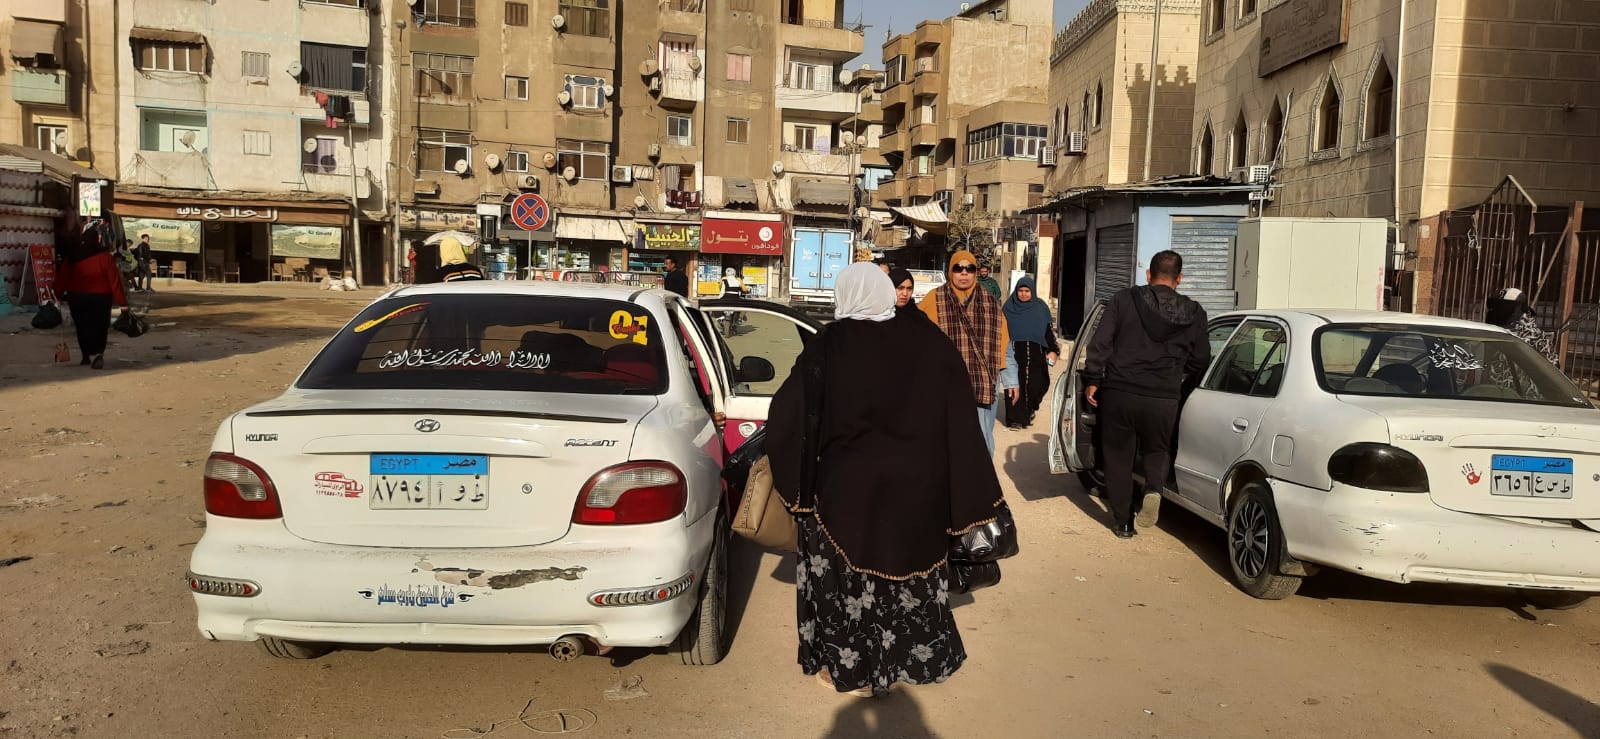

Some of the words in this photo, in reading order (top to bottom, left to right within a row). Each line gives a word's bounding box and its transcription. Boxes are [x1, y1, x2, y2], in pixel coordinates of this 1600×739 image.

[645, 226, 691, 247] الحبيب
[706, 229, 750, 246] بتول
[380, 458, 420, 470] EGYPT
[442, 458, 478, 470] مصر
[1498, 458, 1526, 469] EGYPT
[1543, 461, 1566, 469] مصر
[372, 480, 425, 503] ٨٧٩٤
